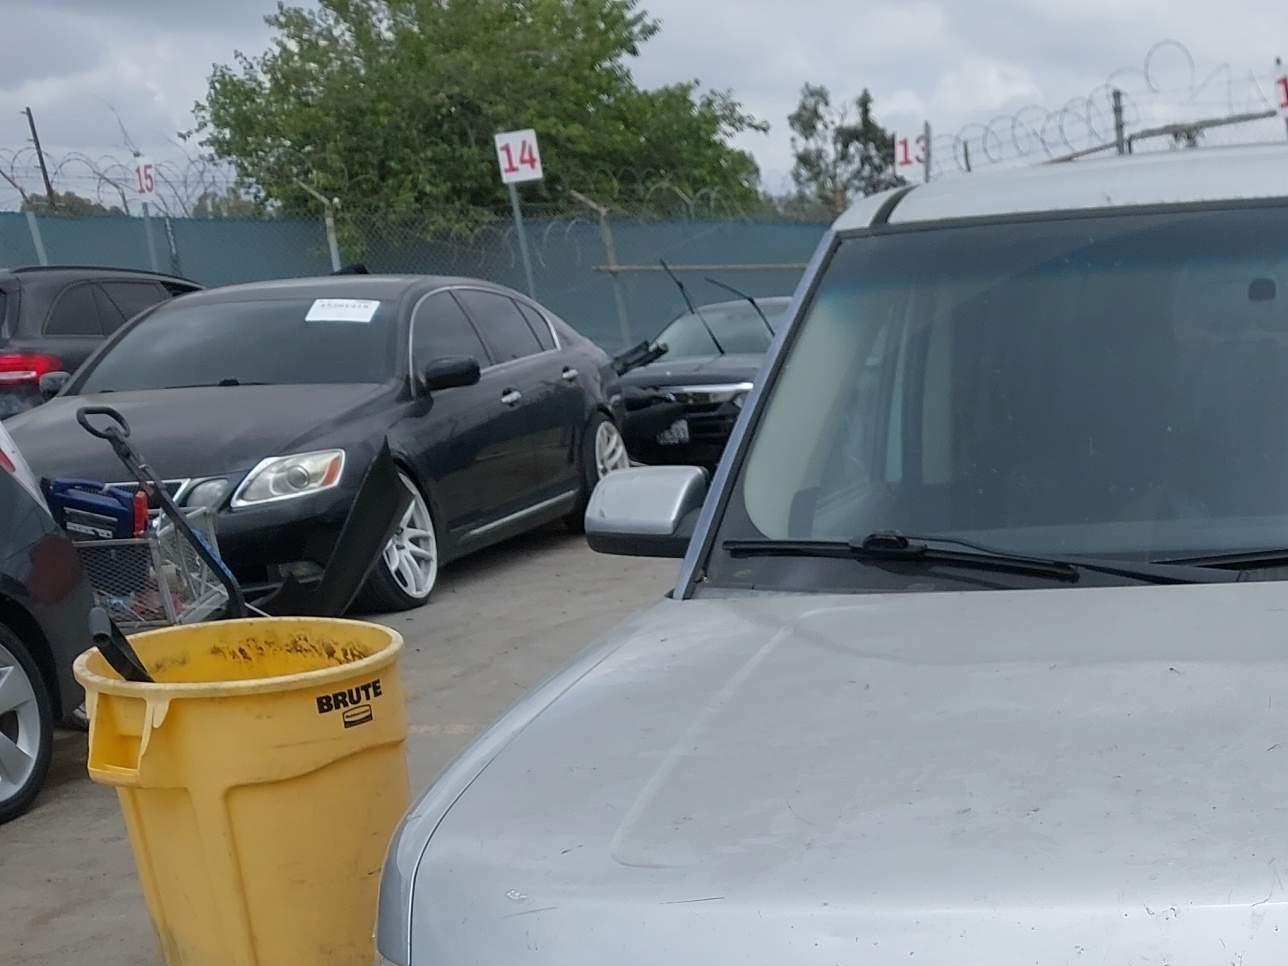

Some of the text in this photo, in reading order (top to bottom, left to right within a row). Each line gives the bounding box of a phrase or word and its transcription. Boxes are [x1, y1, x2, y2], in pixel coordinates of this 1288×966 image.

[499, 139, 537, 174] 14
[135, 163, 154, 194] 15
[316, 678, 383, 714] BRUTE
